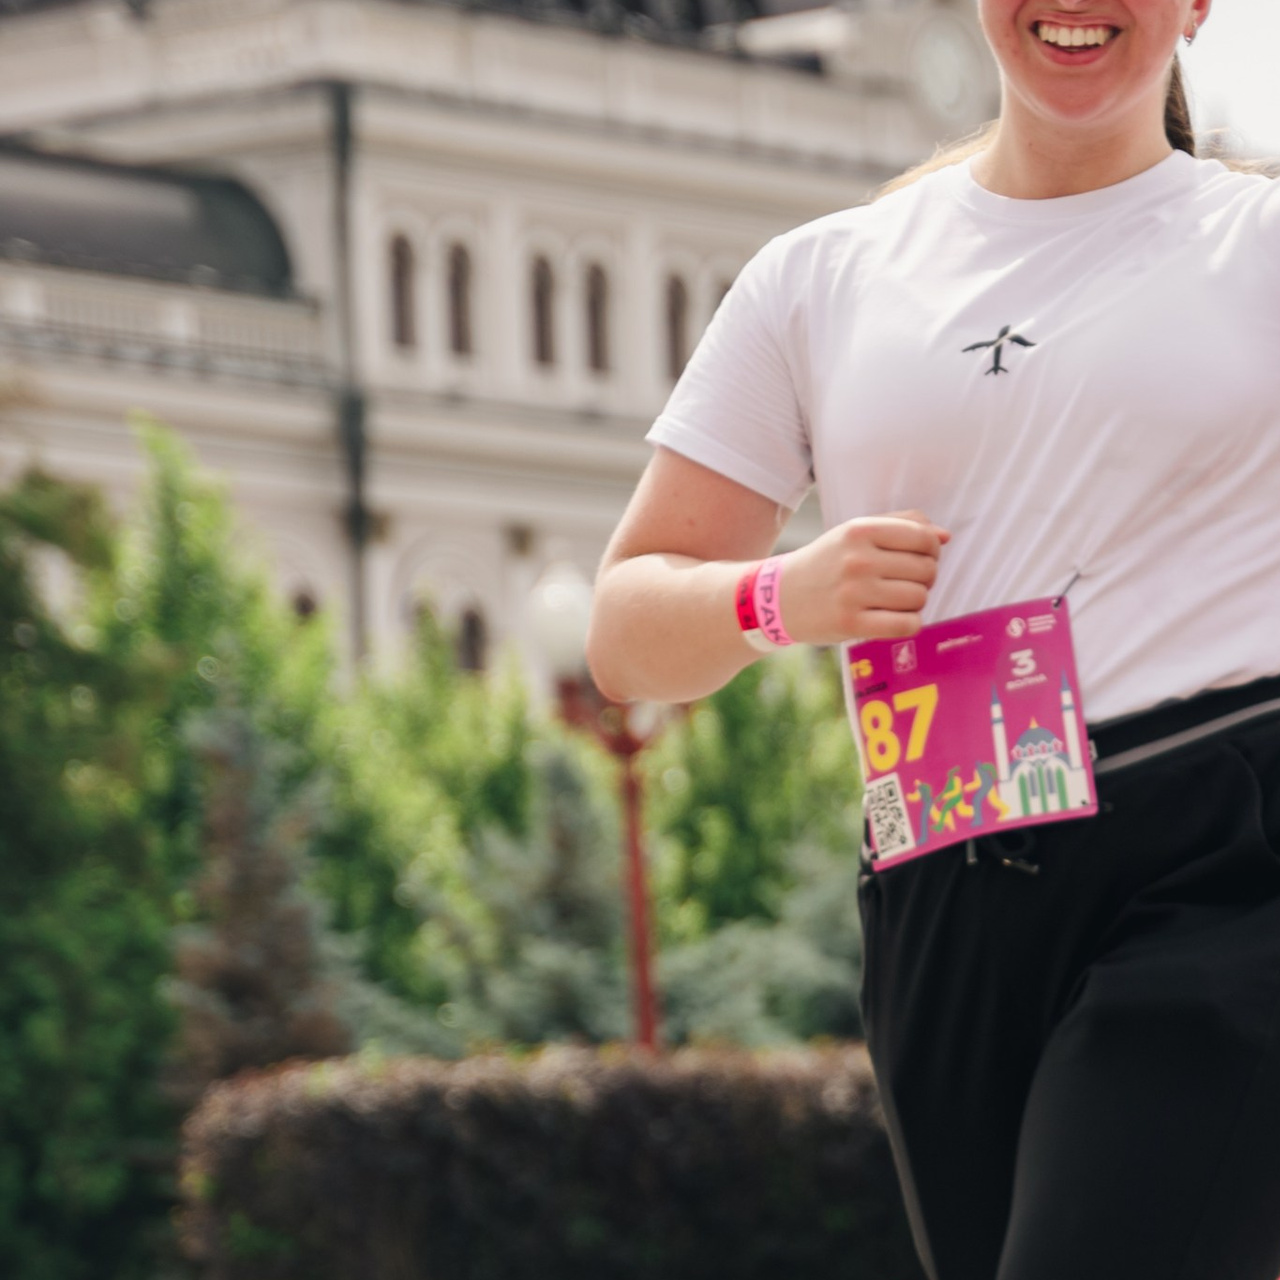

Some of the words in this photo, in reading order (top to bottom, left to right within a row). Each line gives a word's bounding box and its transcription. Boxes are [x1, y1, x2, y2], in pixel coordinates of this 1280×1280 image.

[760, 561, 791, 642] ТРАК
[1009, 648, 1036, 677] 3
[860, 683, 938, 775] 87
